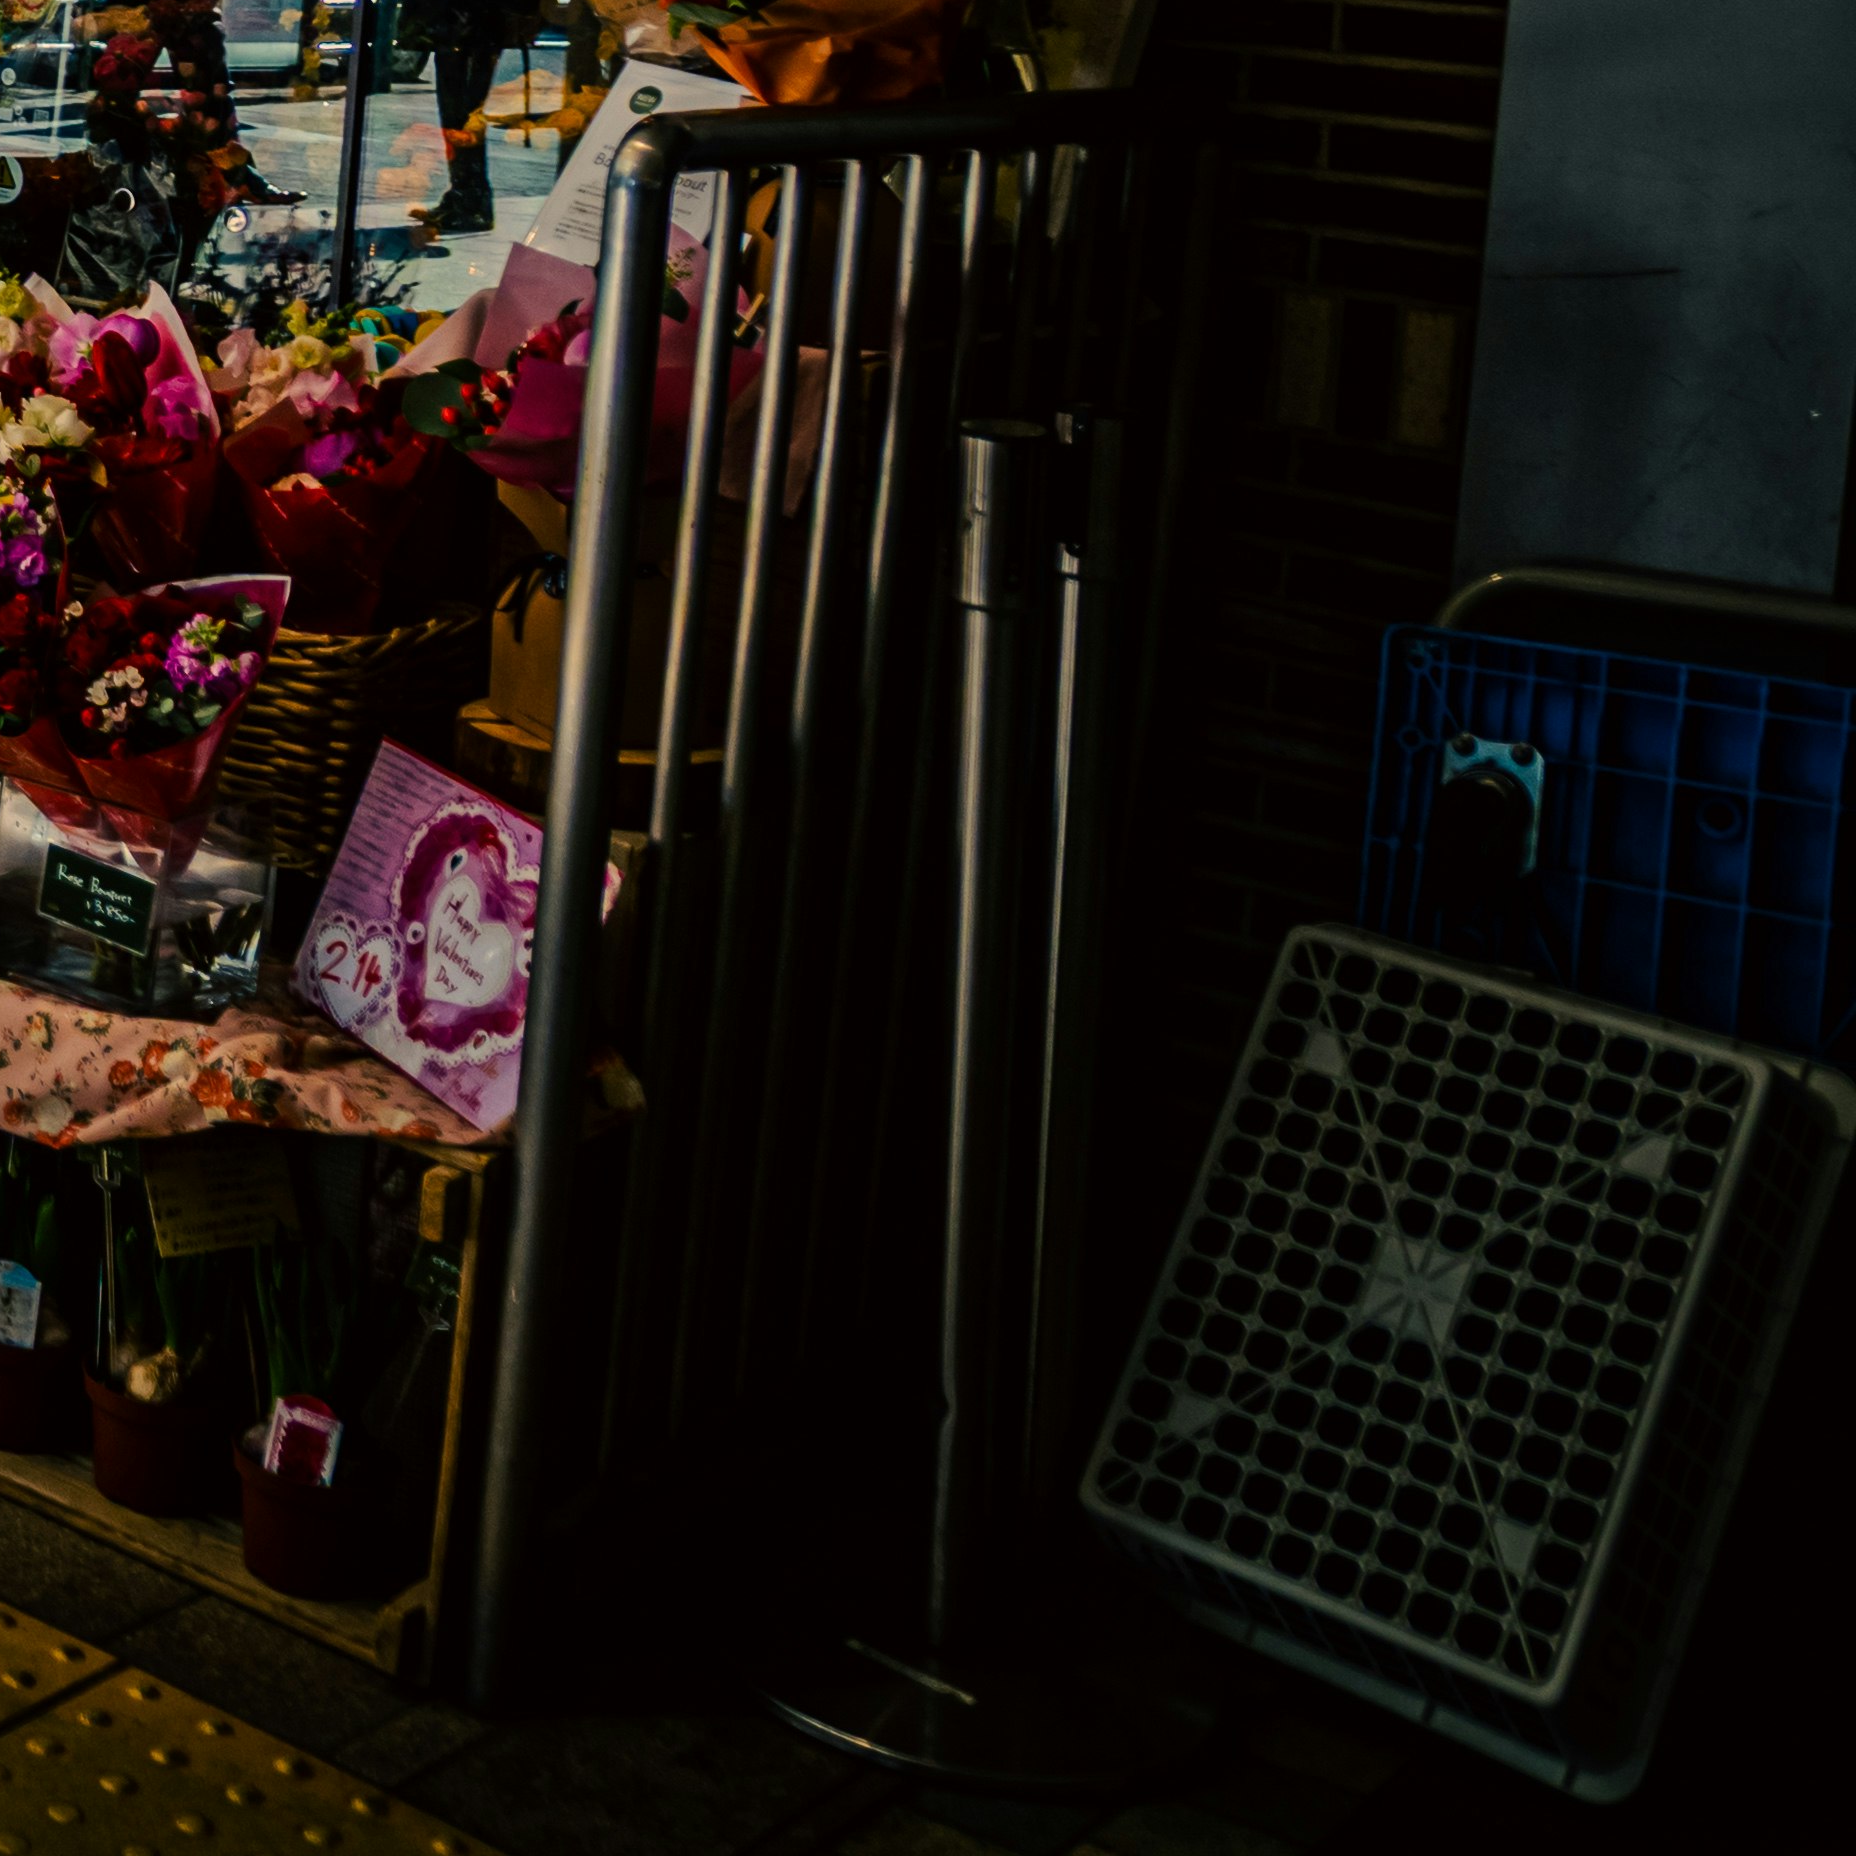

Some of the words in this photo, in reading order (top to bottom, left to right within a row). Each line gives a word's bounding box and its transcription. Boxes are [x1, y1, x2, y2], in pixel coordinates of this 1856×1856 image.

[444, 892, 482, 940] Happy
[319, 940, 382, 999] 2.14
[434, 963, 459, 995] Day
